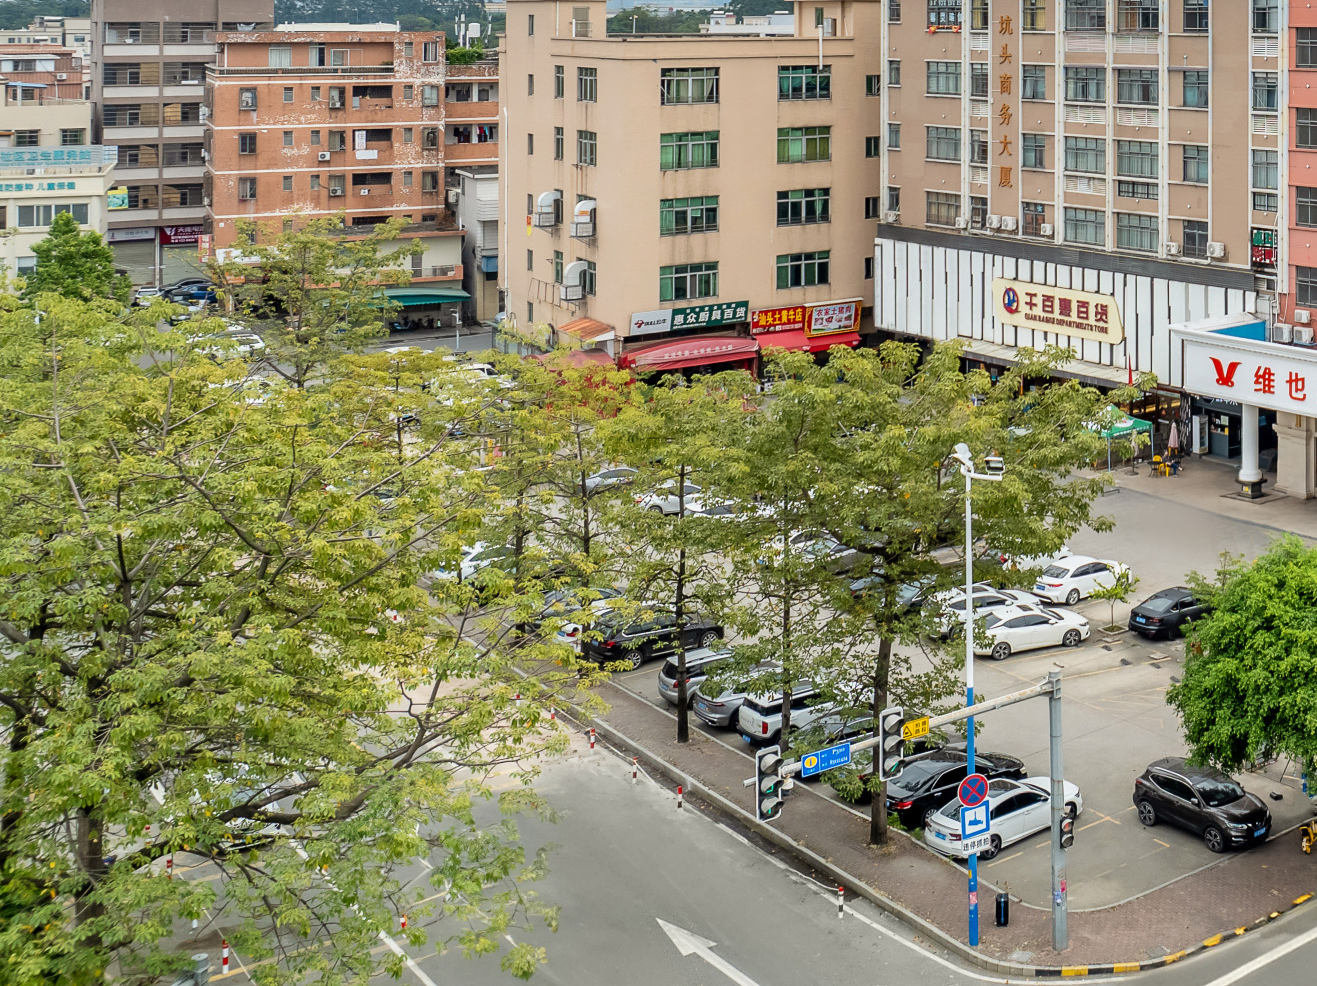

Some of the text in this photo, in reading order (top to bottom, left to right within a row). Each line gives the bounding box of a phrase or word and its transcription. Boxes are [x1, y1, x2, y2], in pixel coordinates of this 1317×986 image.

[998, 15, 1013, 188] 坑头商务大厦
[673, 307, 746, 325] 惠众厨具百货
[759, 308, 802, 326] 汕头土黄牛店
[1024, 292, 1109, 324] 千百惠百货
